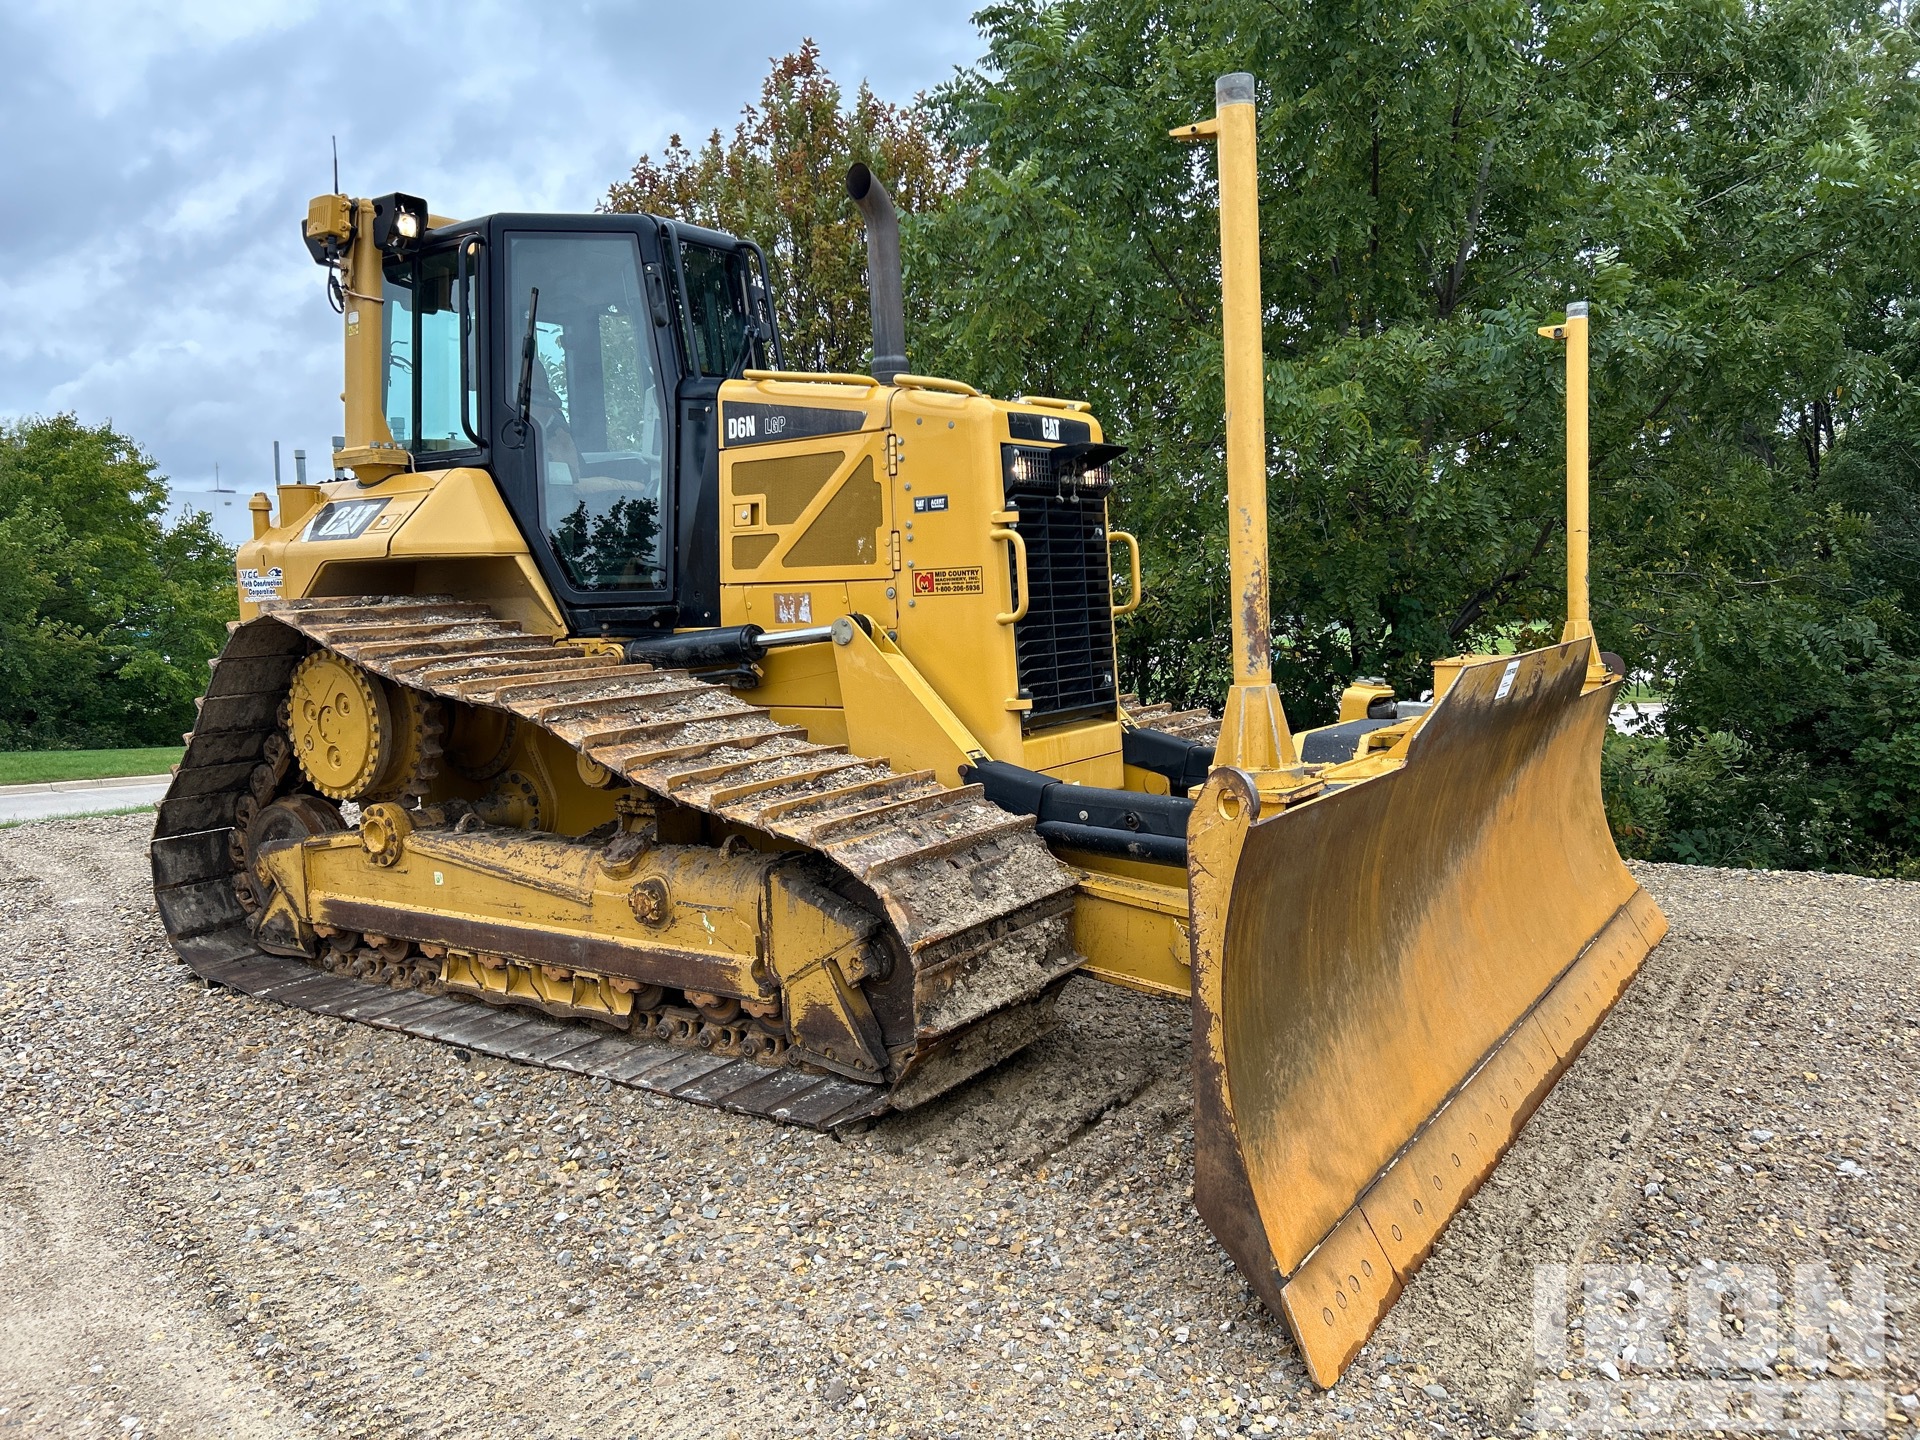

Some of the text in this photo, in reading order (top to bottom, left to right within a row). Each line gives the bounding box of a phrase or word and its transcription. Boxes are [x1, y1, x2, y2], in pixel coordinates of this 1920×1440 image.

[728, 415, 786, 439] D6N LGP
[1041, 417, 1060, 440] CAT
[318, 503, 382, 536] CAT
[948, 569, 979, 577] COUNTRY
[253, 579, 283, 587] Construction
[248, 588, 276, 596] Corporation
